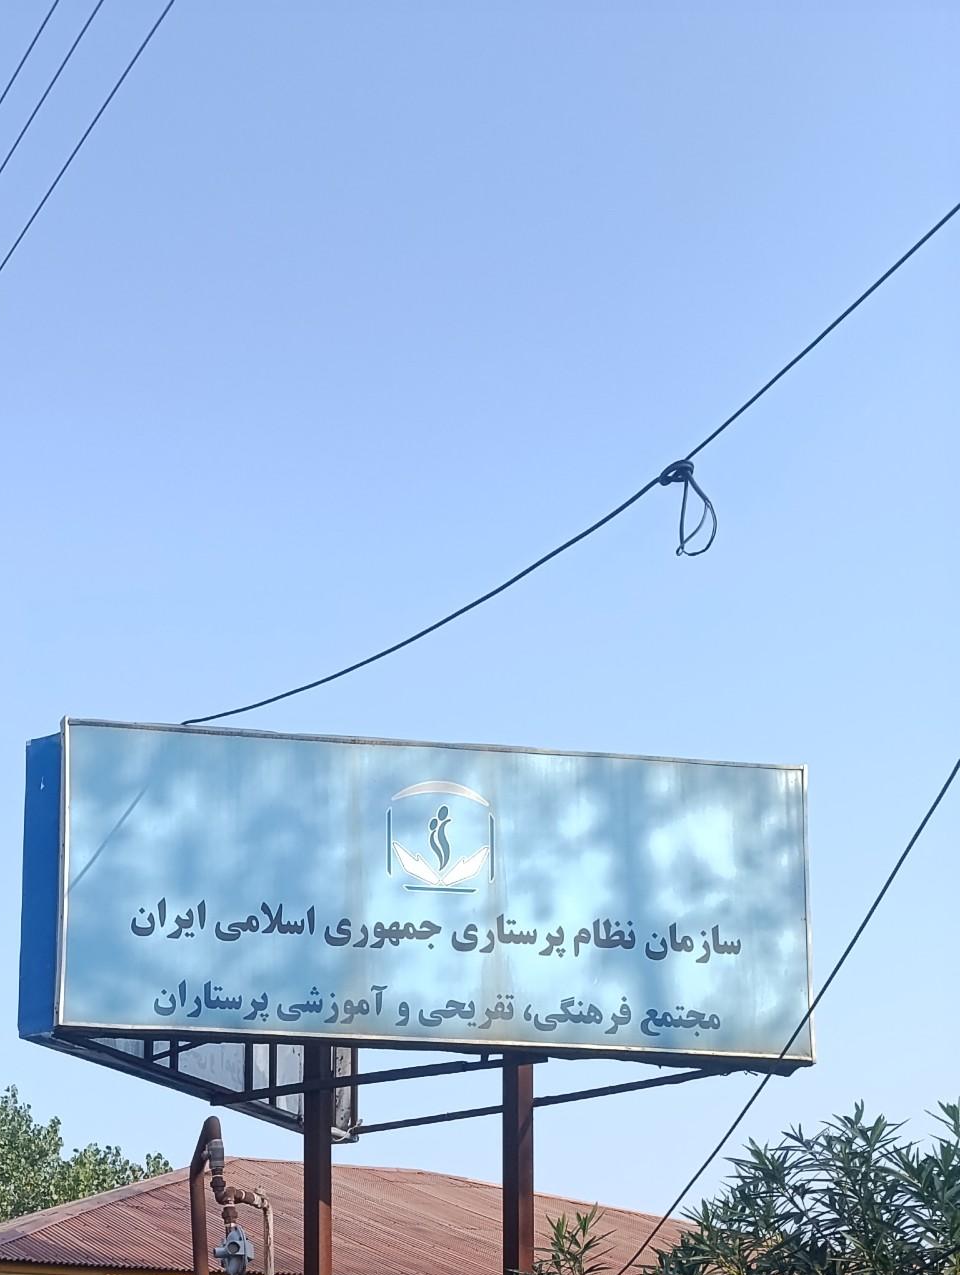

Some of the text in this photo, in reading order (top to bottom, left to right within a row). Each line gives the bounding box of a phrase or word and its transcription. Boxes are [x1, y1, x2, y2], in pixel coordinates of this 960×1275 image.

[131, 897, 742, 964] سازمان نظام پرستاری جمهوری اسلامی ایران
[153, 979, 269, 1022] پرستاران
[276, 984, 388, 1025] آموزشی
[395, 1000, 410, 1026] و
[418, 993, 515, 1030] تفریحی
[640, 1005, 721, 1037] مجتمع
